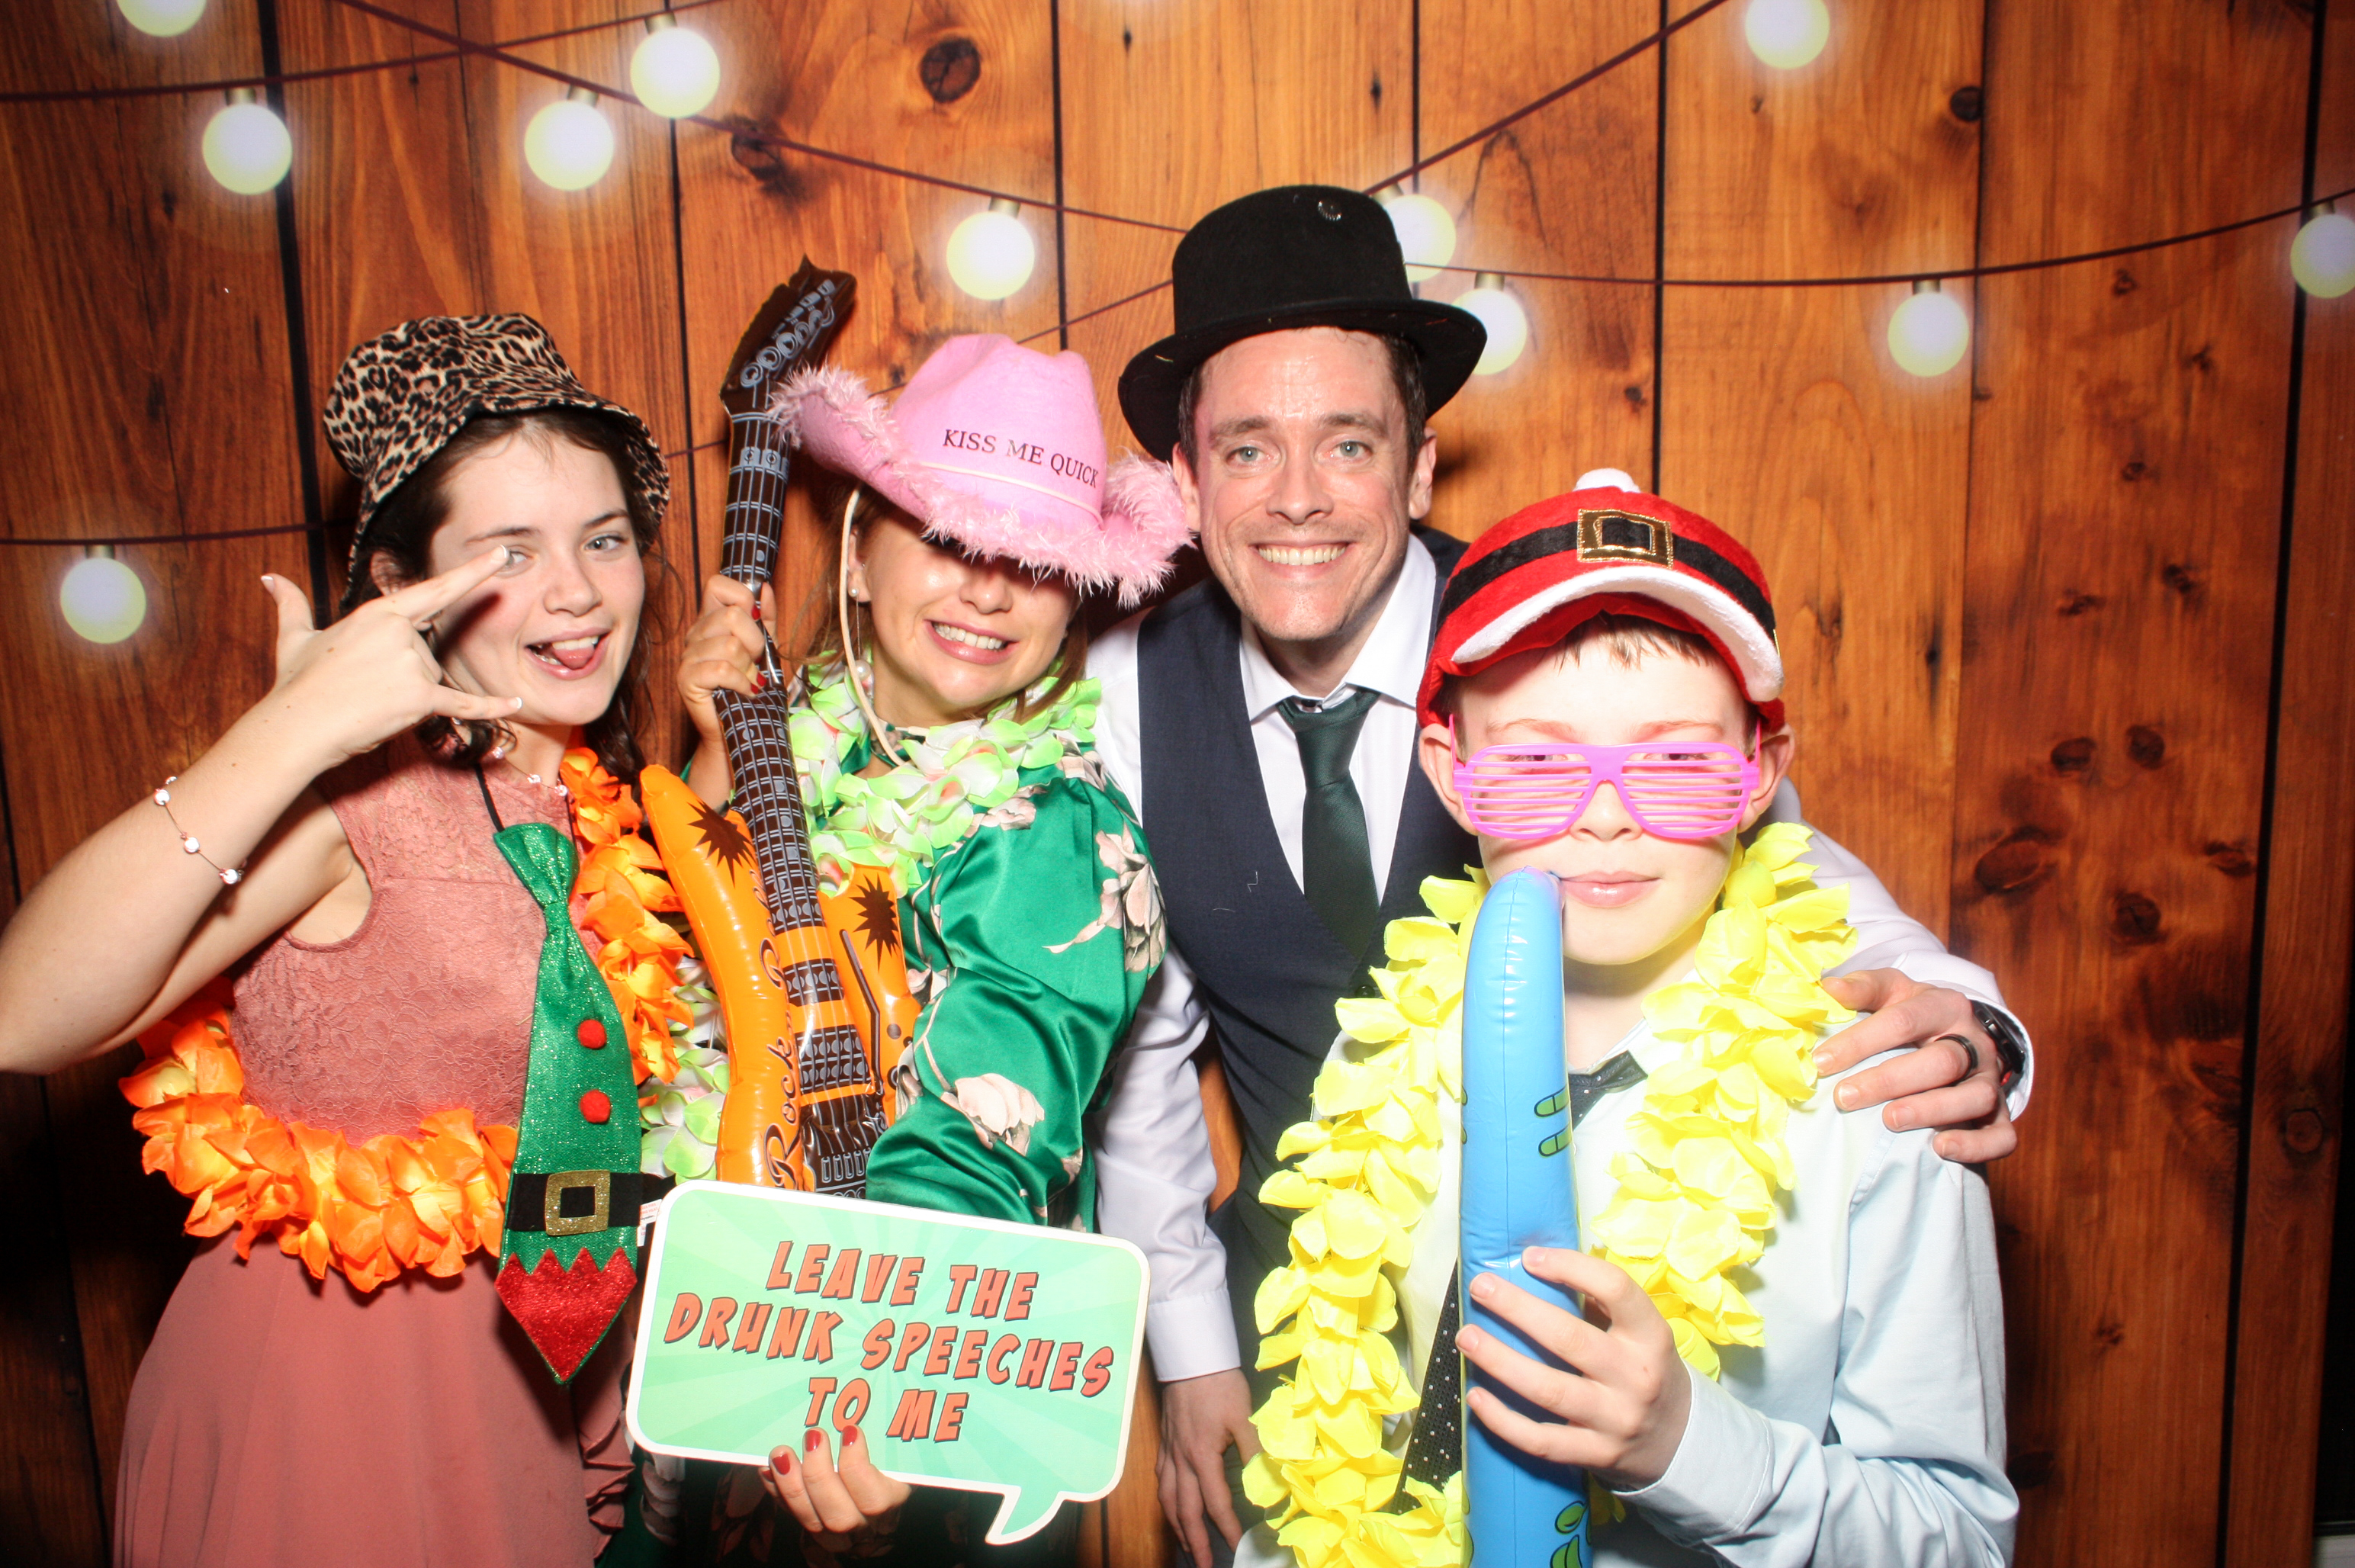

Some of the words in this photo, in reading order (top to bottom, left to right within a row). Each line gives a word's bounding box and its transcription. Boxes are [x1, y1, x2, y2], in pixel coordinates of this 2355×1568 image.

[943, 429, 997, 453] KISS
[1006, 439, 1045, 465] ME
[1050, 453, 1099, 488] QUICK
[764, 1036, 801, 1190] Rock
[766, 1241, 925, 1306] LEAVE
[946, 1264, 1039, 1321] THE
[663, 1293, 843, 1363] DRUNK
[860, 1319, 1114, 1397] SPEECHES
[805, 1377, 871, 1433] TO
[885, 1389, 969, 1443] ME
